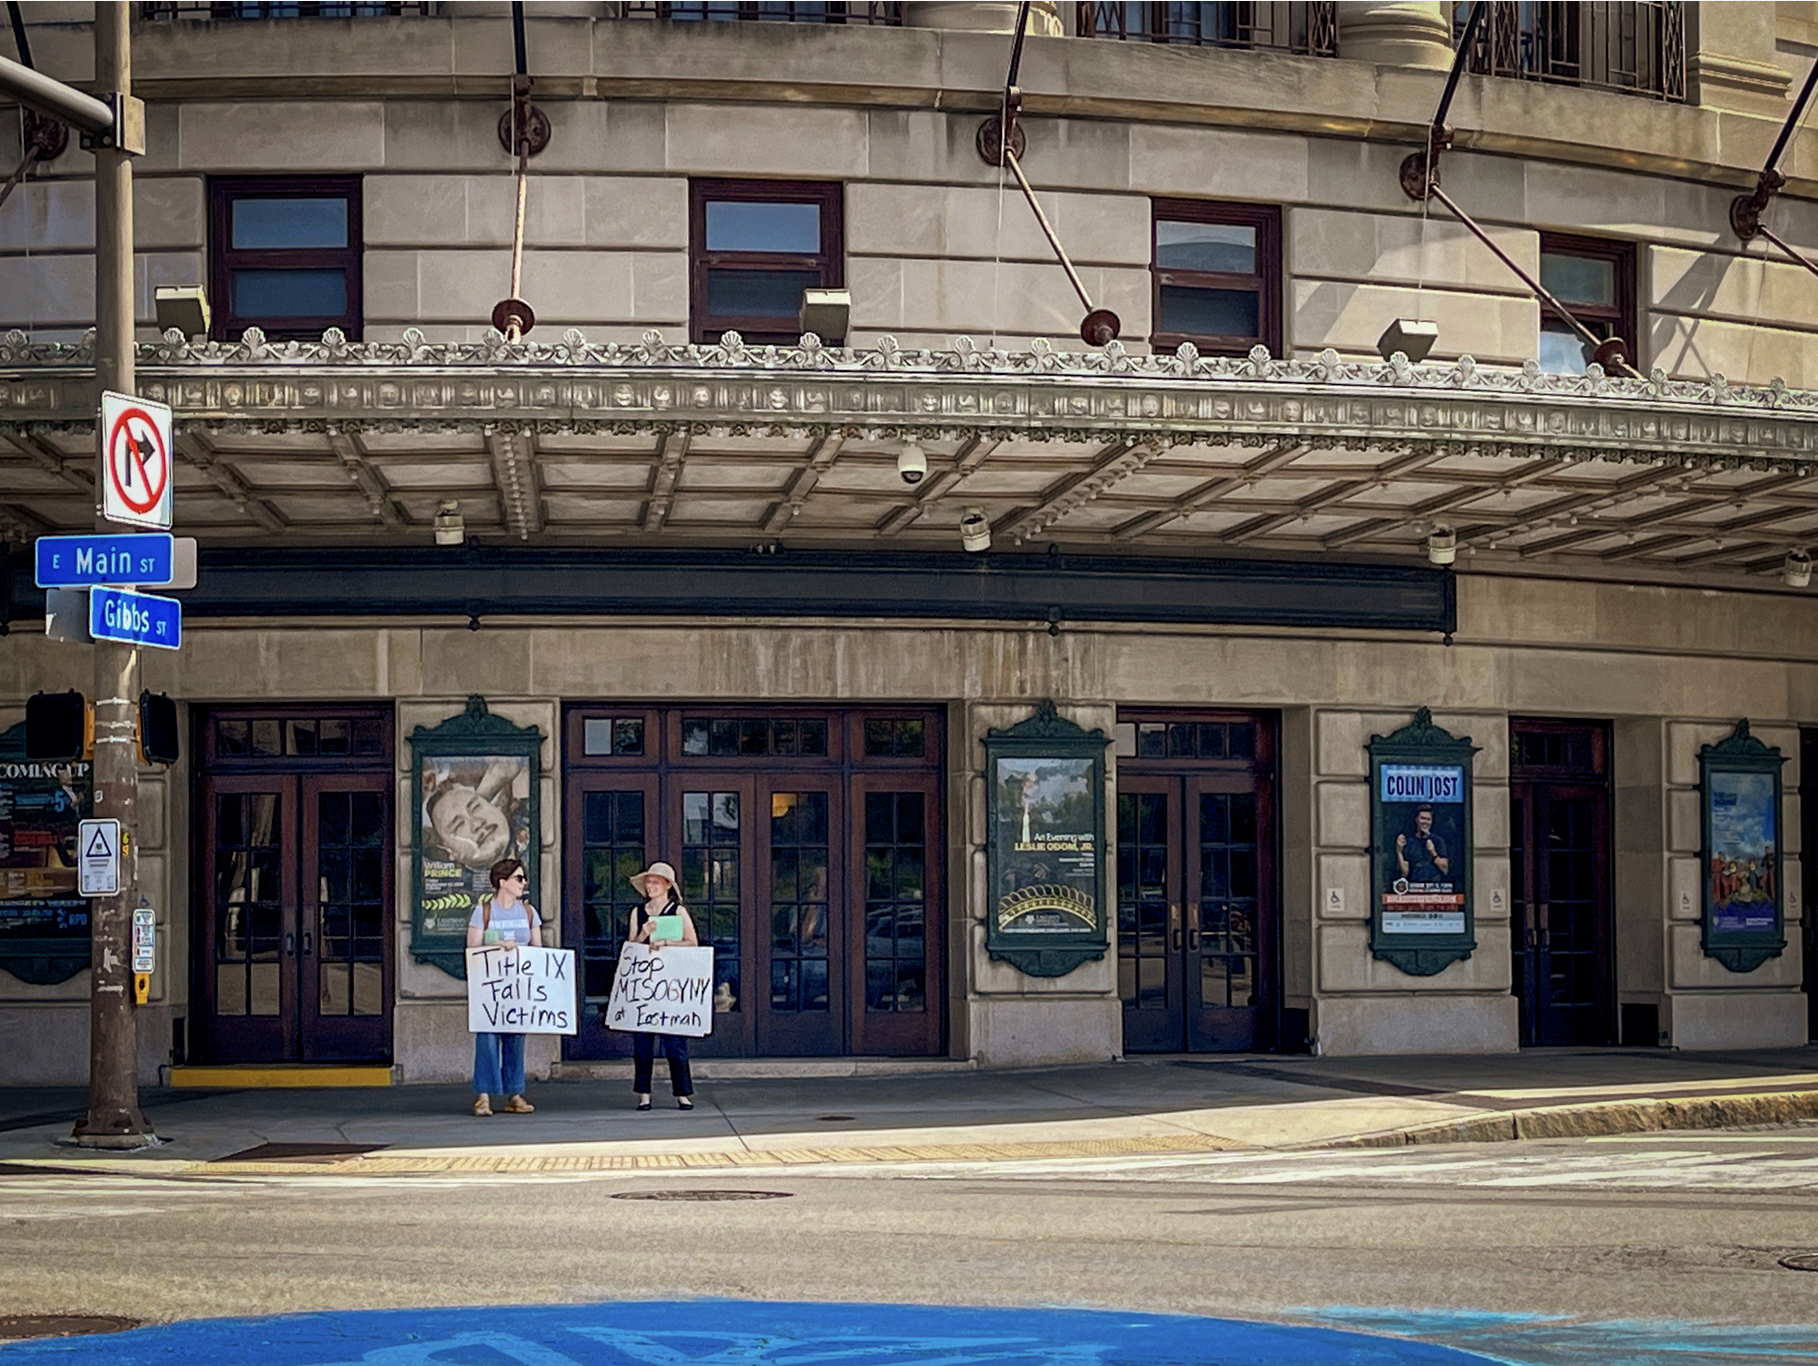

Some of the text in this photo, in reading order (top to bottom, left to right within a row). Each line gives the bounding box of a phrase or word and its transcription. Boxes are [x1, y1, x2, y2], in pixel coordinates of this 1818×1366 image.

[53, 547, 155, 574] E Main ST
[105, 599, 167, 636] Gibbs ST
[1387, 775, 1458, 799] COLIN JOST
[1014, 842, 1046, 852] LESLIE
[424, 868, 462, 878] PRINCE
[472, 947, 567, 980] Title IX
[620, 946, 665, 980] Stop
[614, 977, 710, 1005] MISOGYNY
[482, 1001, 568, 1028] Victims
[636, 1003, 702, 1027] Eastman
